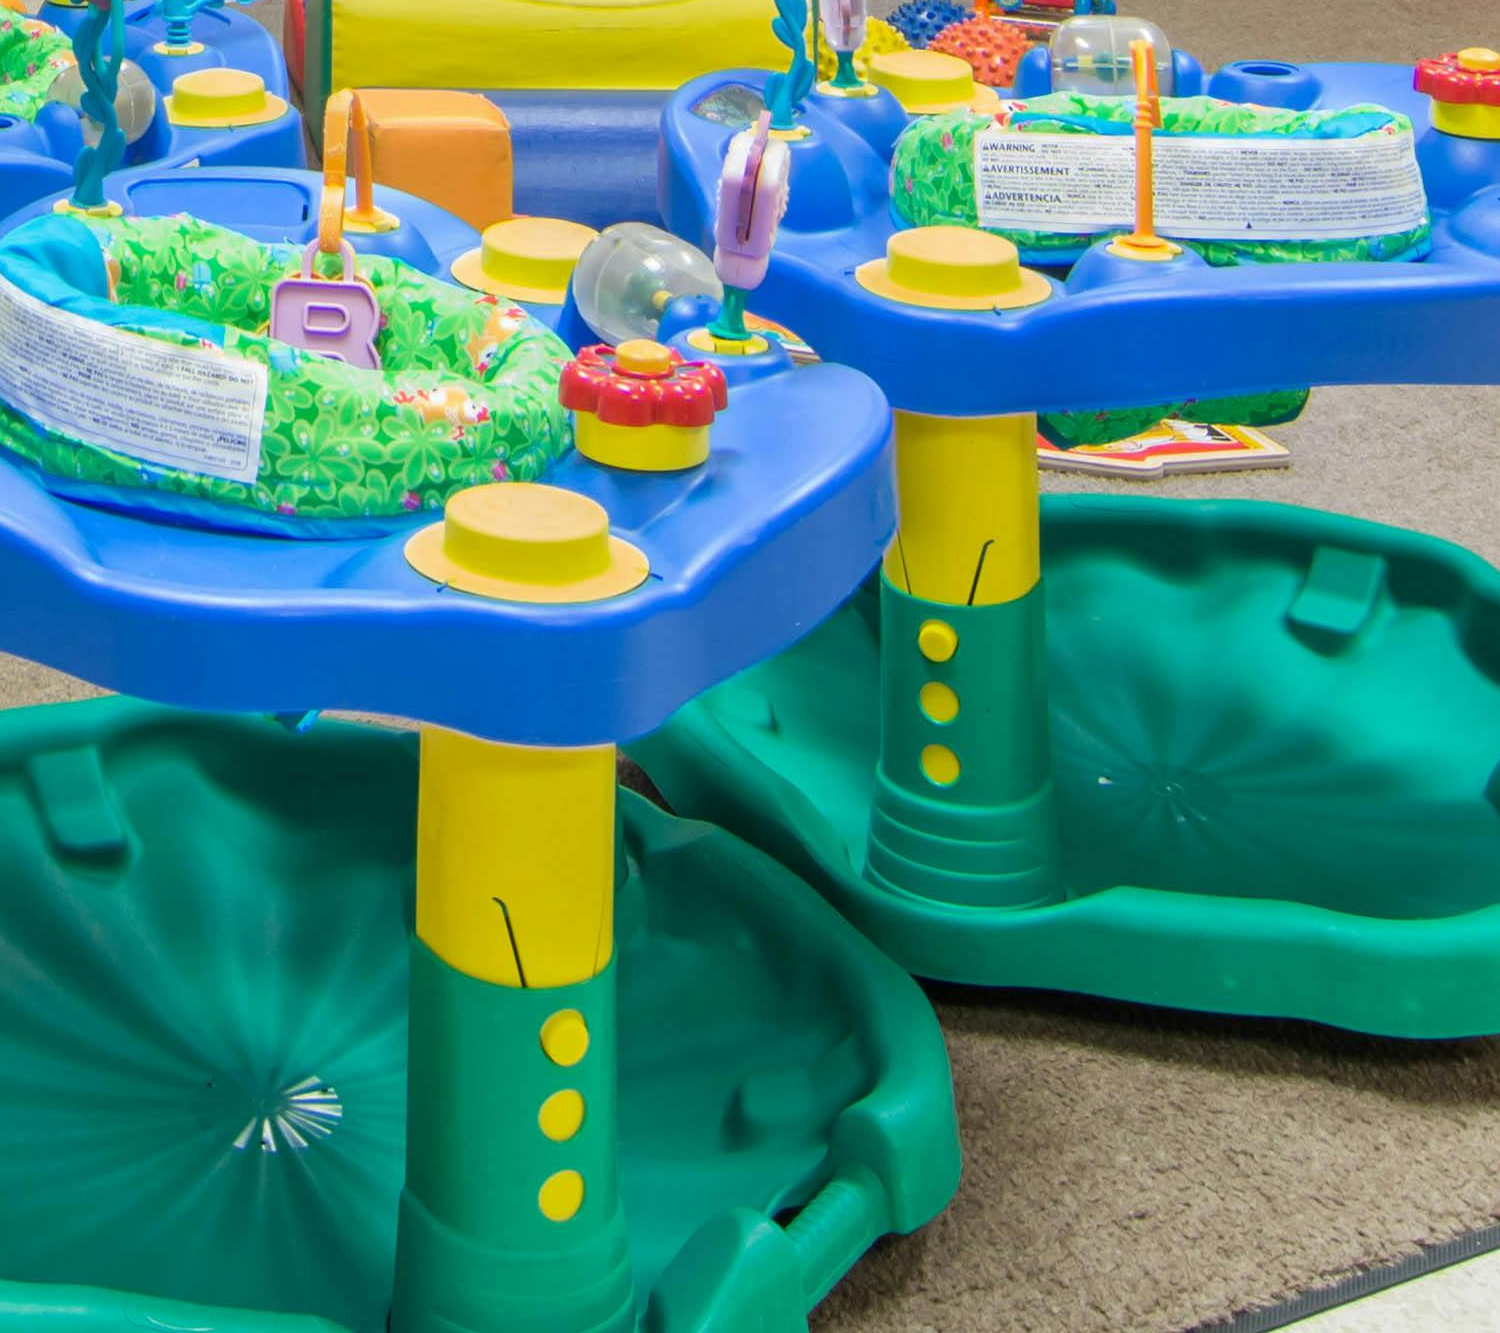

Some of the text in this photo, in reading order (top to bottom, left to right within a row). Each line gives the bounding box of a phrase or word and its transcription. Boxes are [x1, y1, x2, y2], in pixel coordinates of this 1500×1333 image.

[990, 142, 1036, 153] WARNING
[990, 164, 1070, 176] AVERTISSEMENT
[992, 191, 1062, 203] ADVERTENCIA
